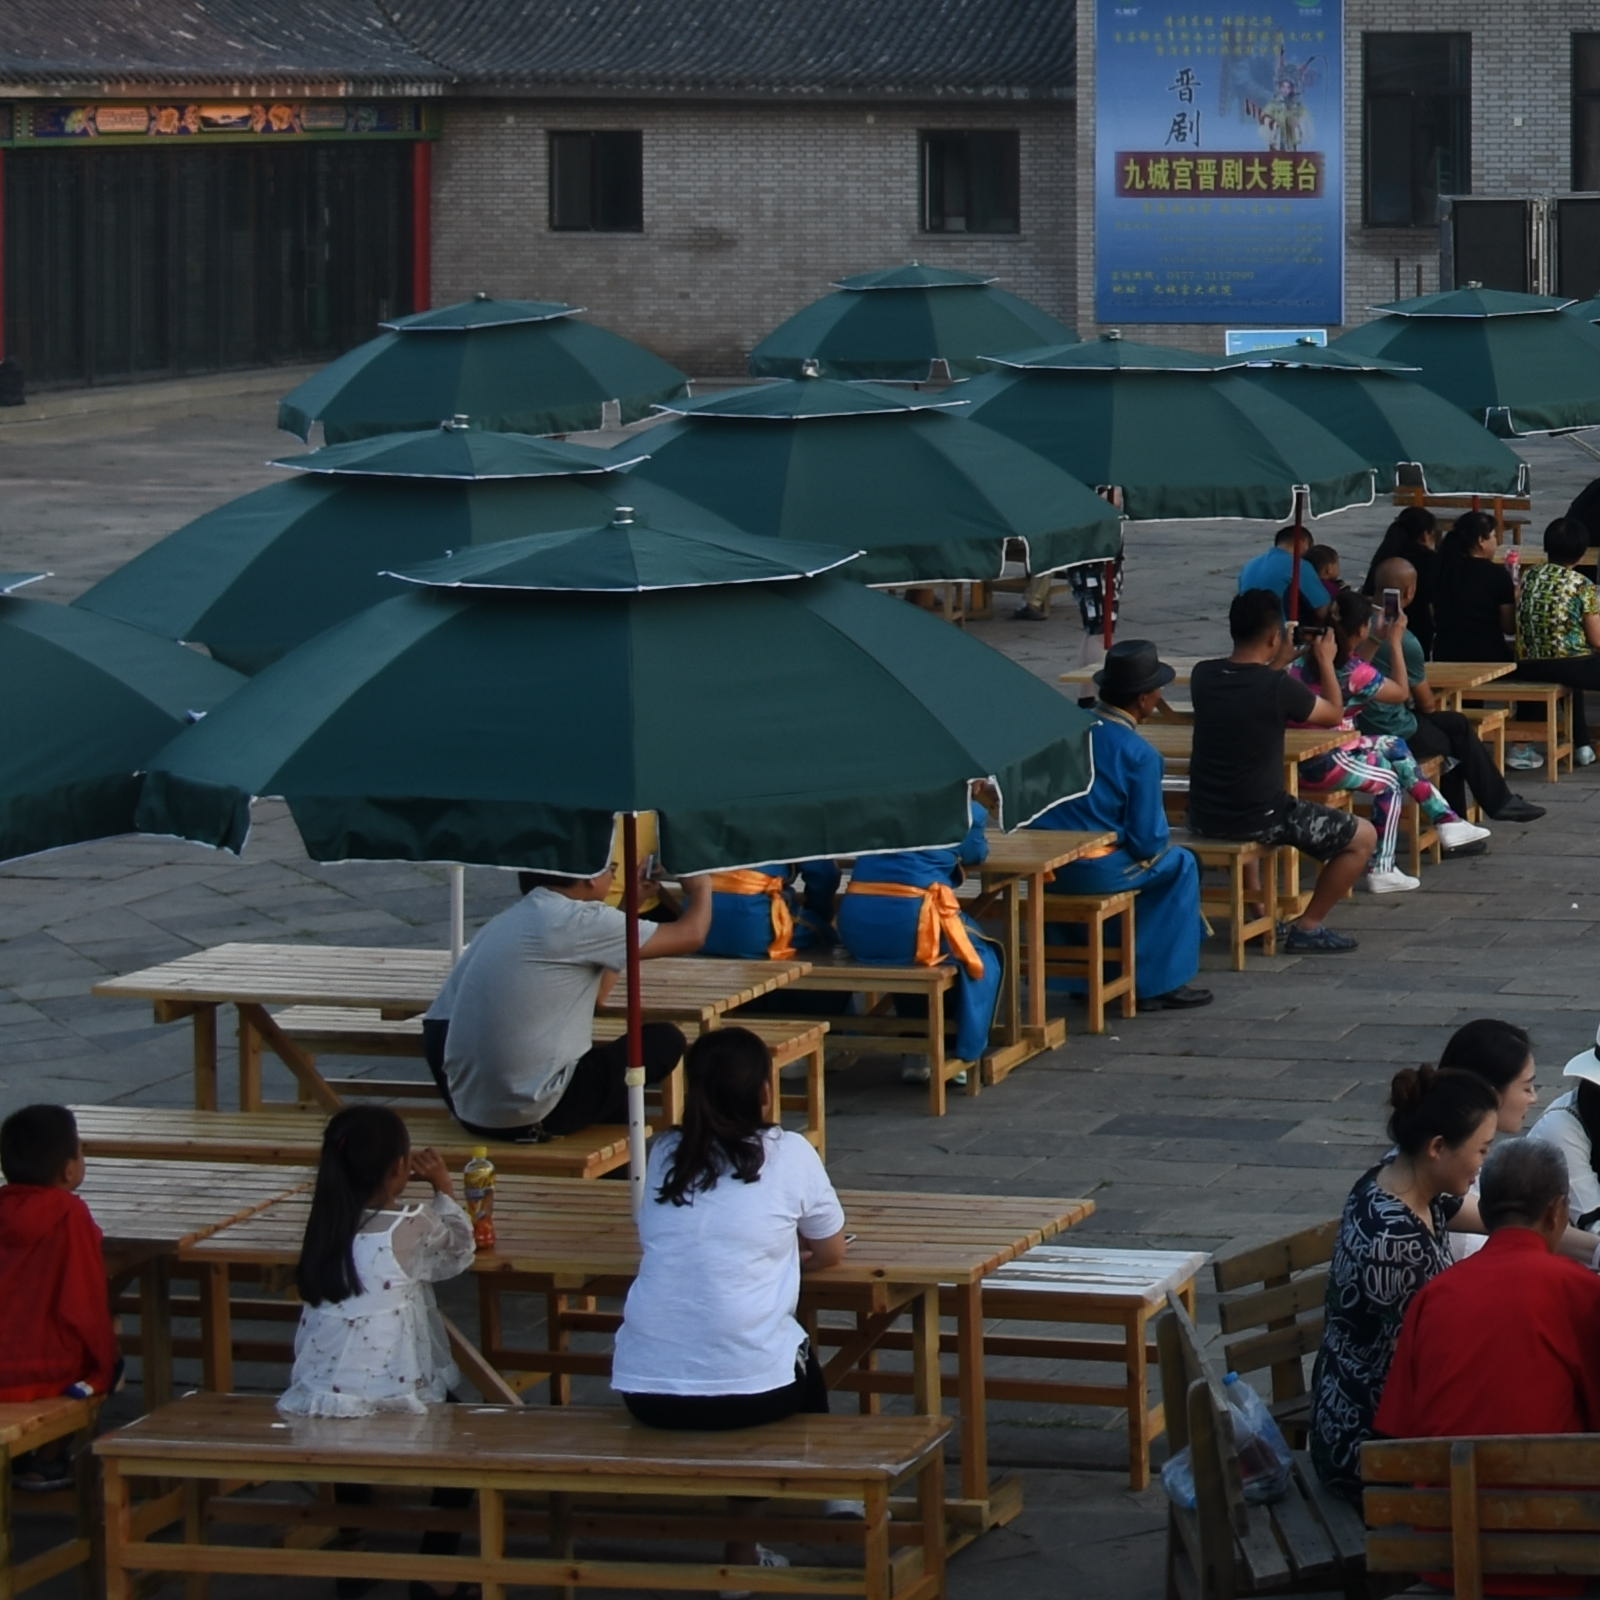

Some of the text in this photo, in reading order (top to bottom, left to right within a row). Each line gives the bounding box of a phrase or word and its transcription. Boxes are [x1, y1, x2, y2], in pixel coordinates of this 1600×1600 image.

[1124, 157, 1317, 191] 九城宫晋剧大舞台
